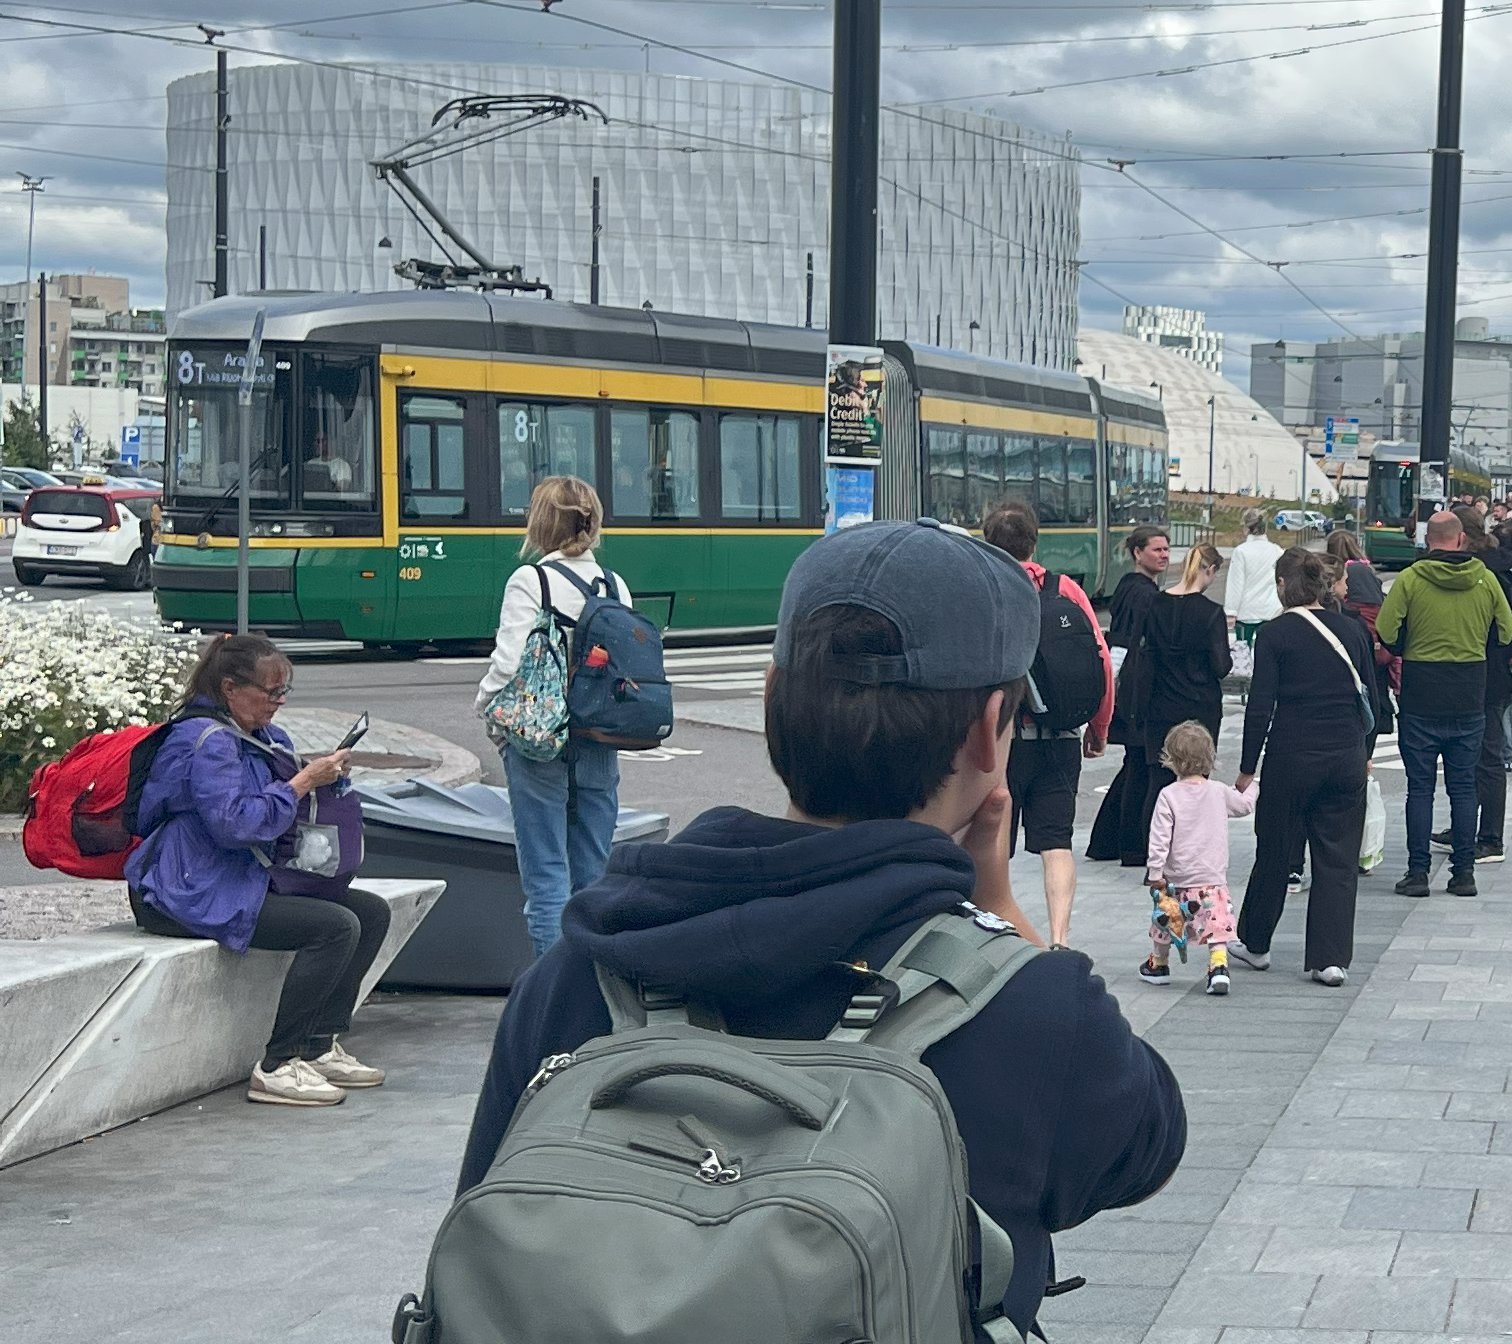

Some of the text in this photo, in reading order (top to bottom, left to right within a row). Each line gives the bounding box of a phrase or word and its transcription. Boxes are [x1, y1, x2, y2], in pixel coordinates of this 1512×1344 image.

[179, 350, 264, 384] 8T Araa
[125, 427, 139, 443] P
[515, 410, 539, 443] 8T
[399, 567, 422, 580] 409
